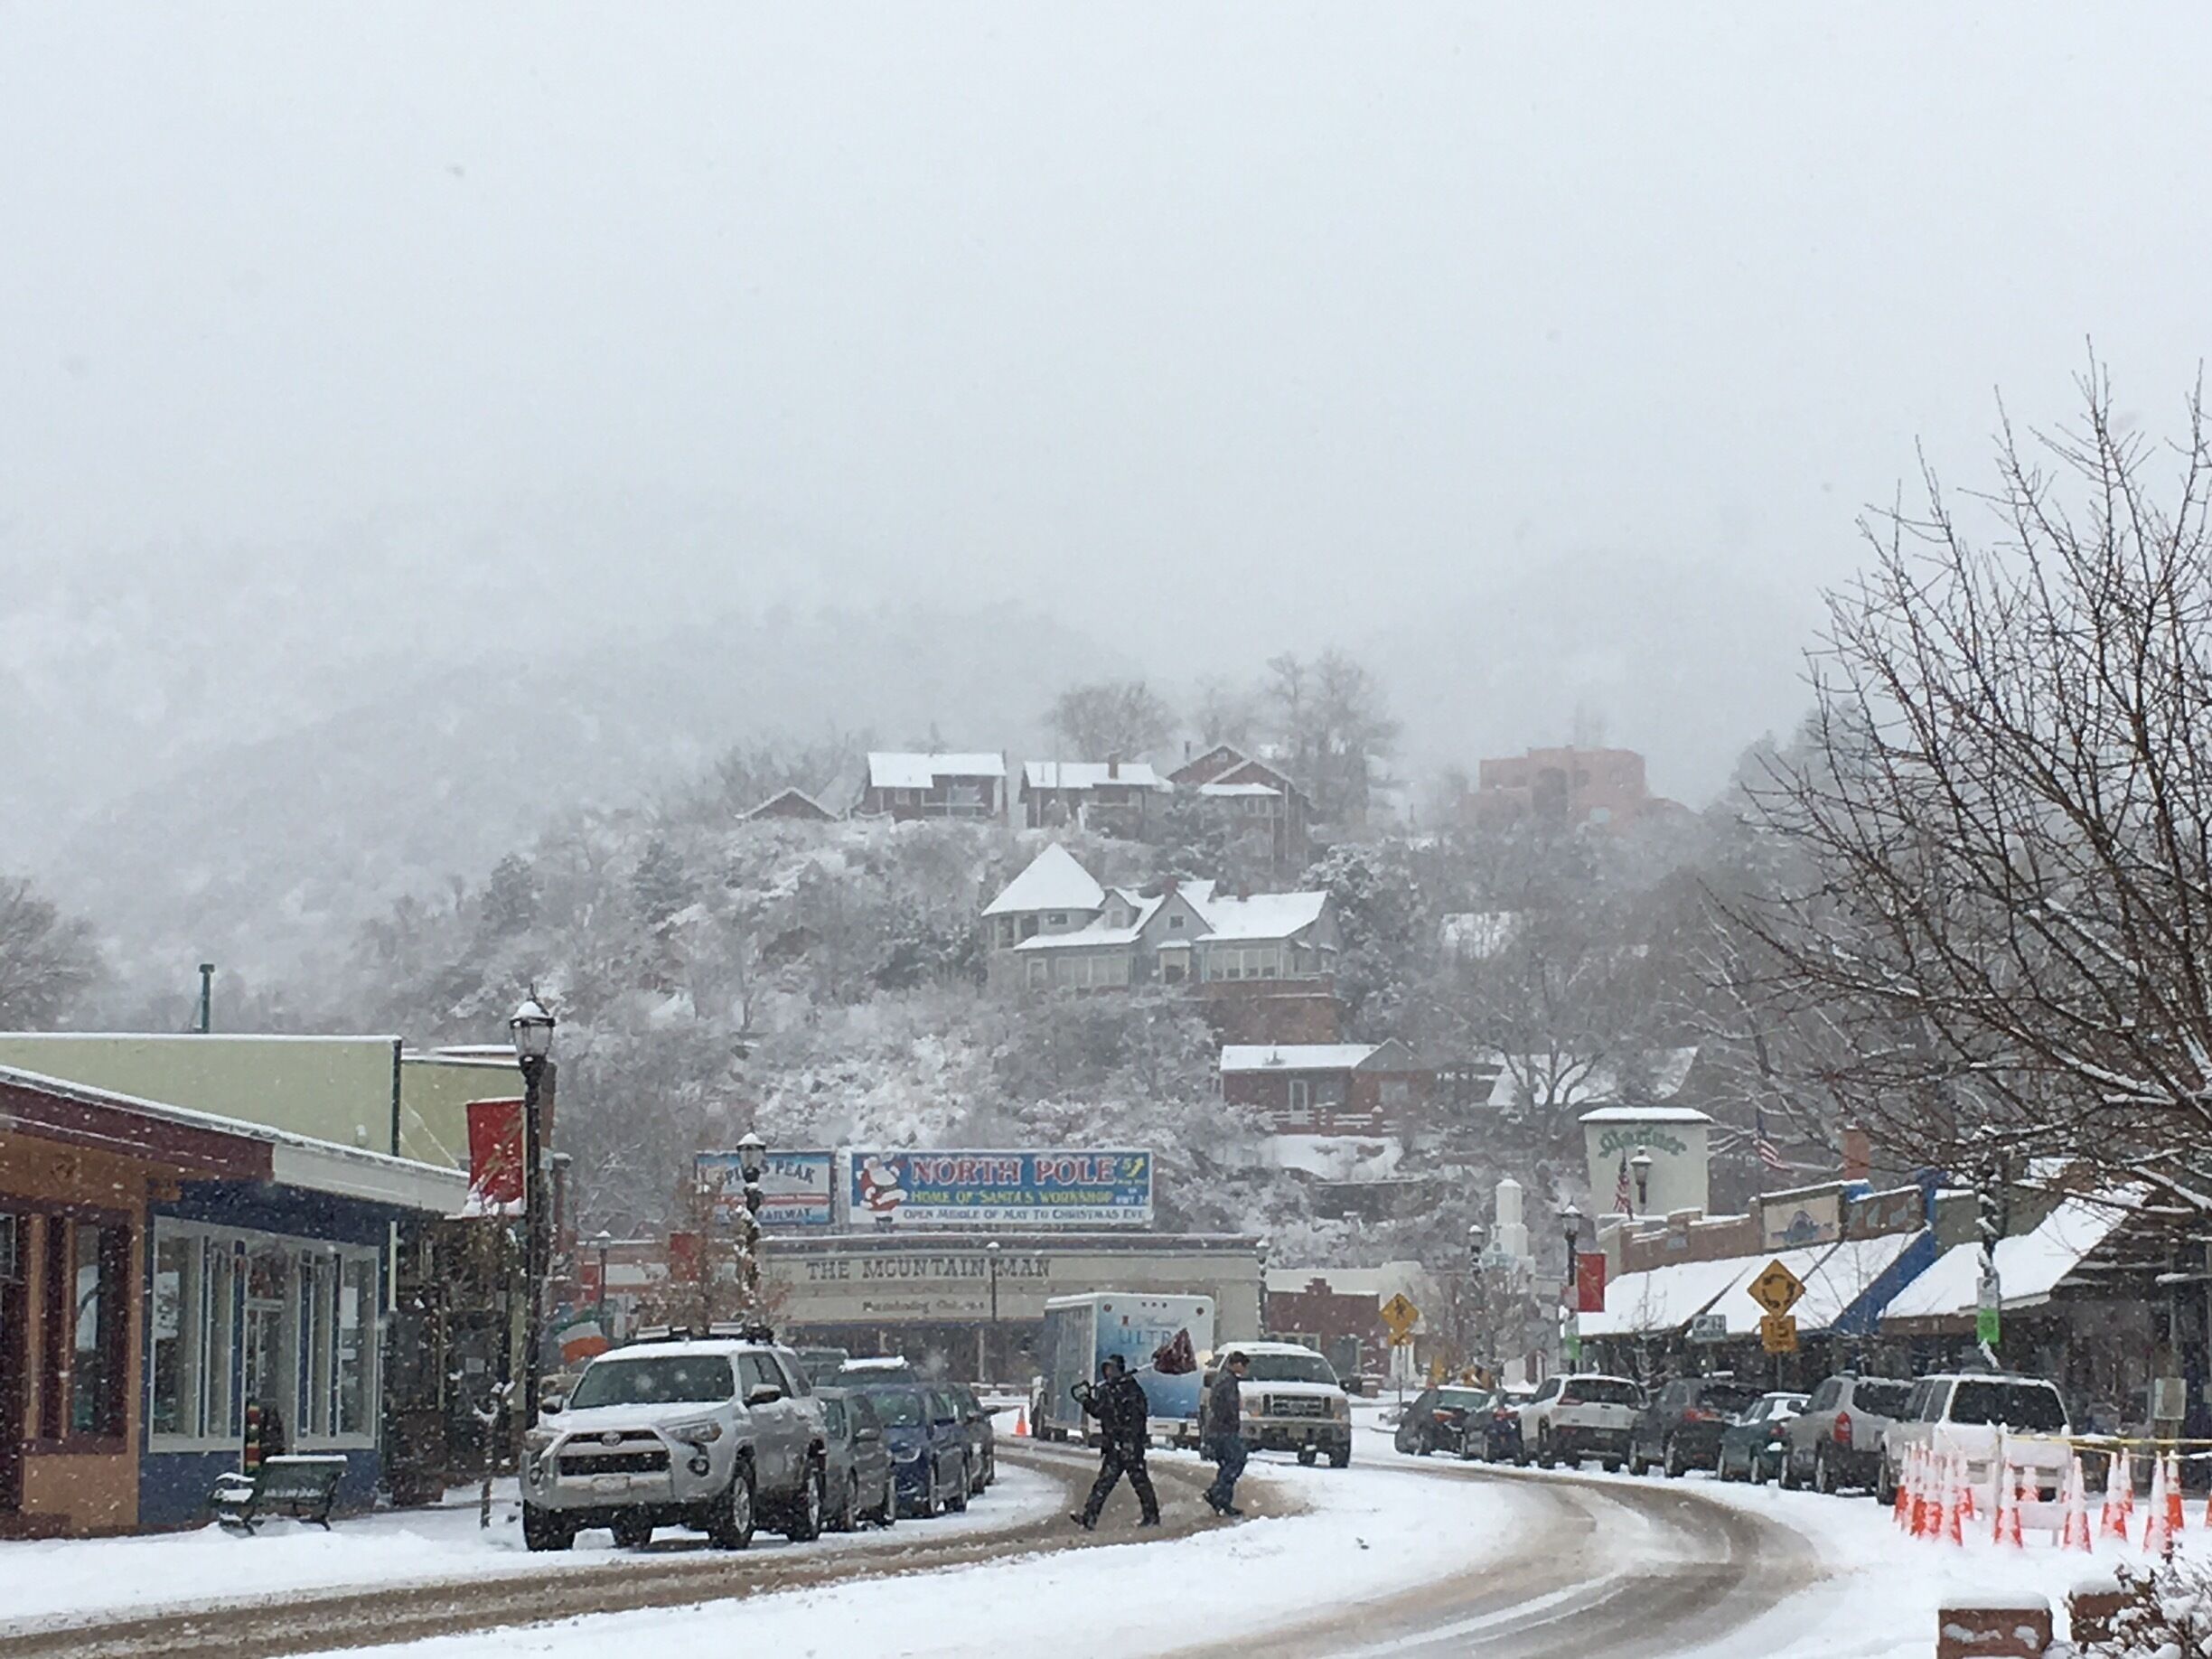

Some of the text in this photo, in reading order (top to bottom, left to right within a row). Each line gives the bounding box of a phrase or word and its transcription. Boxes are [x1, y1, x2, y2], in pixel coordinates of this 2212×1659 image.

[775, 1159, 815, 1185] PEAK
[911, 1157, 1118, 1186] NORTH POLE
[911, 1191, 950, 1204] HOME
[956, 1191, 974, 1204] OF
[1039, 1191, 1114, 1204] WORKSHOP
[904, 1209, 933, 1219] OPEN
[984, 1209, 998, 1219] OF
[1003, 1209, 1028, 1220] MAY
[1052, 1209, 1120, 1219] CHRISTMAS
[1123, 1209, 1144, 1219] EVE
[806, 1257, 1050, 1280] THE MOUNTAIN MAN
